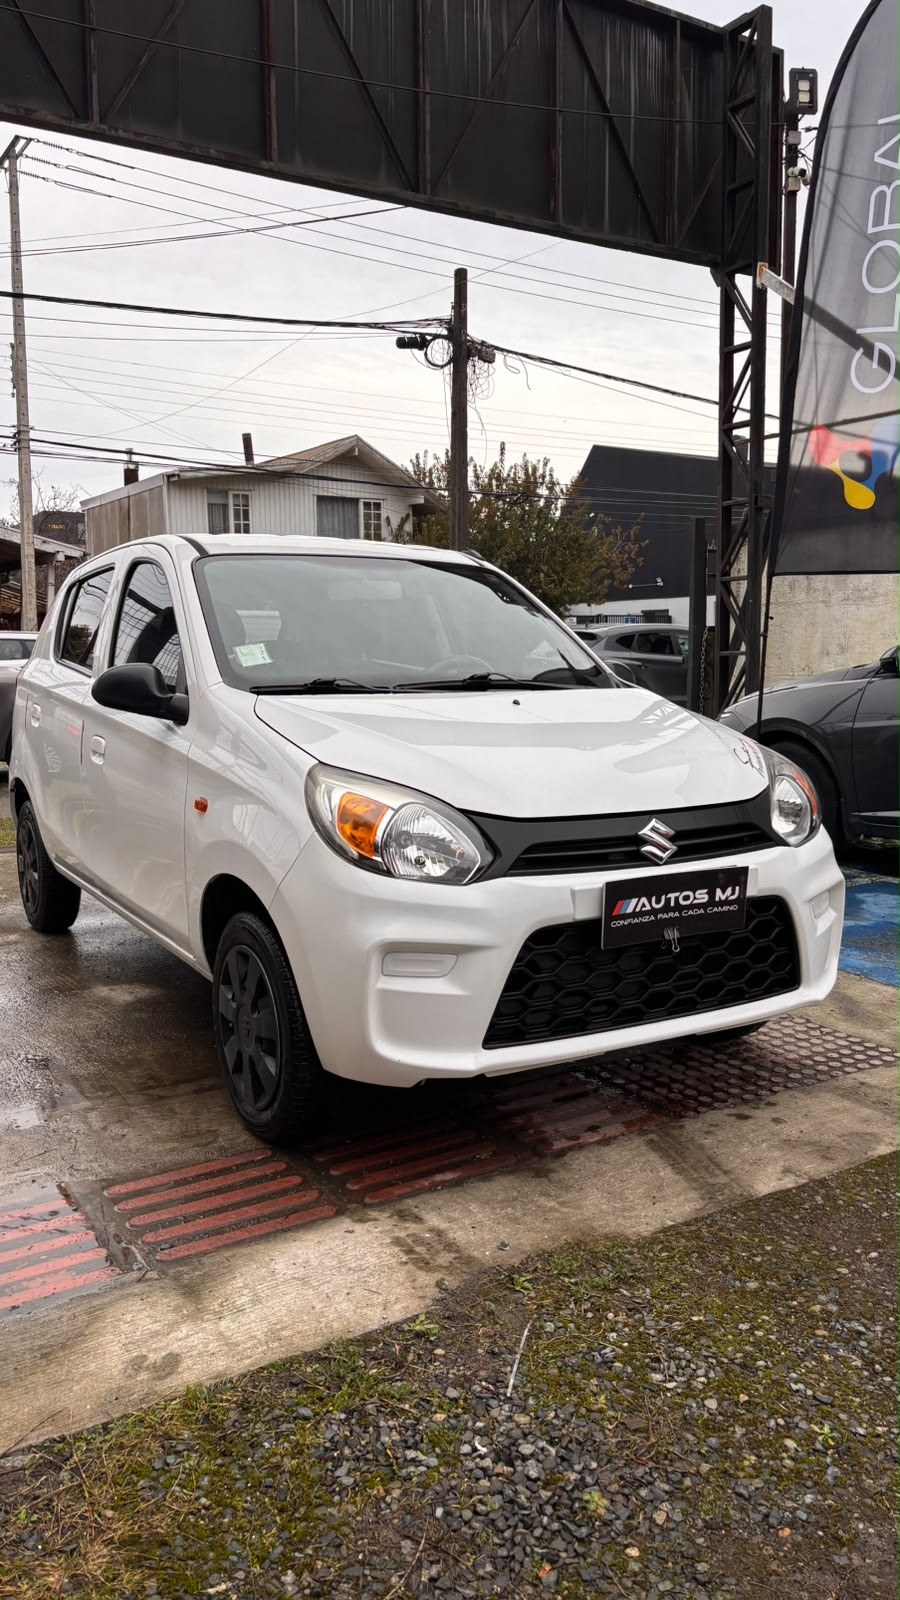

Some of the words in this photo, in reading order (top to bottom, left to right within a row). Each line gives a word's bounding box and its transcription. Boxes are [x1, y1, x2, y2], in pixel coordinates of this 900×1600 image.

[634, 888, 709, 912] AUTOS
[715, 885, 740, 902] MJ
[610, 914, 656, 928] CONFIANZA
[657, 911, 680, 921] PARA
[681, 908, 705, 918] CADA
[706, 904, 739, 914] CAMINO
